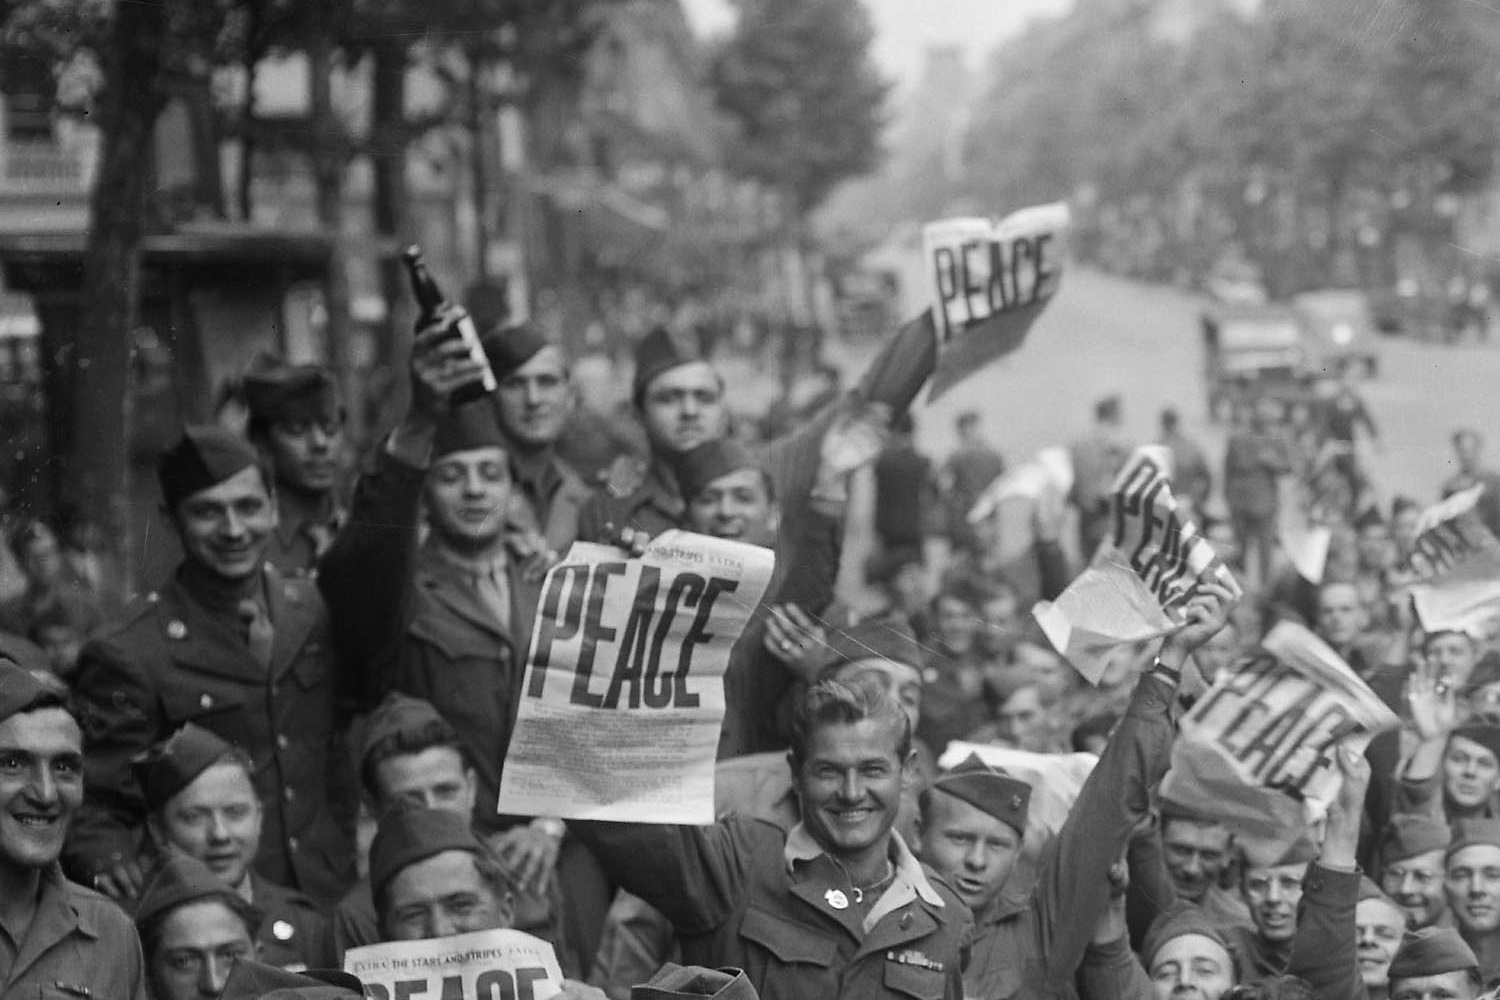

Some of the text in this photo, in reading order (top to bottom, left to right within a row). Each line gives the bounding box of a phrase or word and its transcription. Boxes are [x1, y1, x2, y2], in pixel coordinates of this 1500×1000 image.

[934, 233, 1055, 341] PEACE
[527, 563, 740, 709] PEACE
[392, 959, 408, 970] THE
